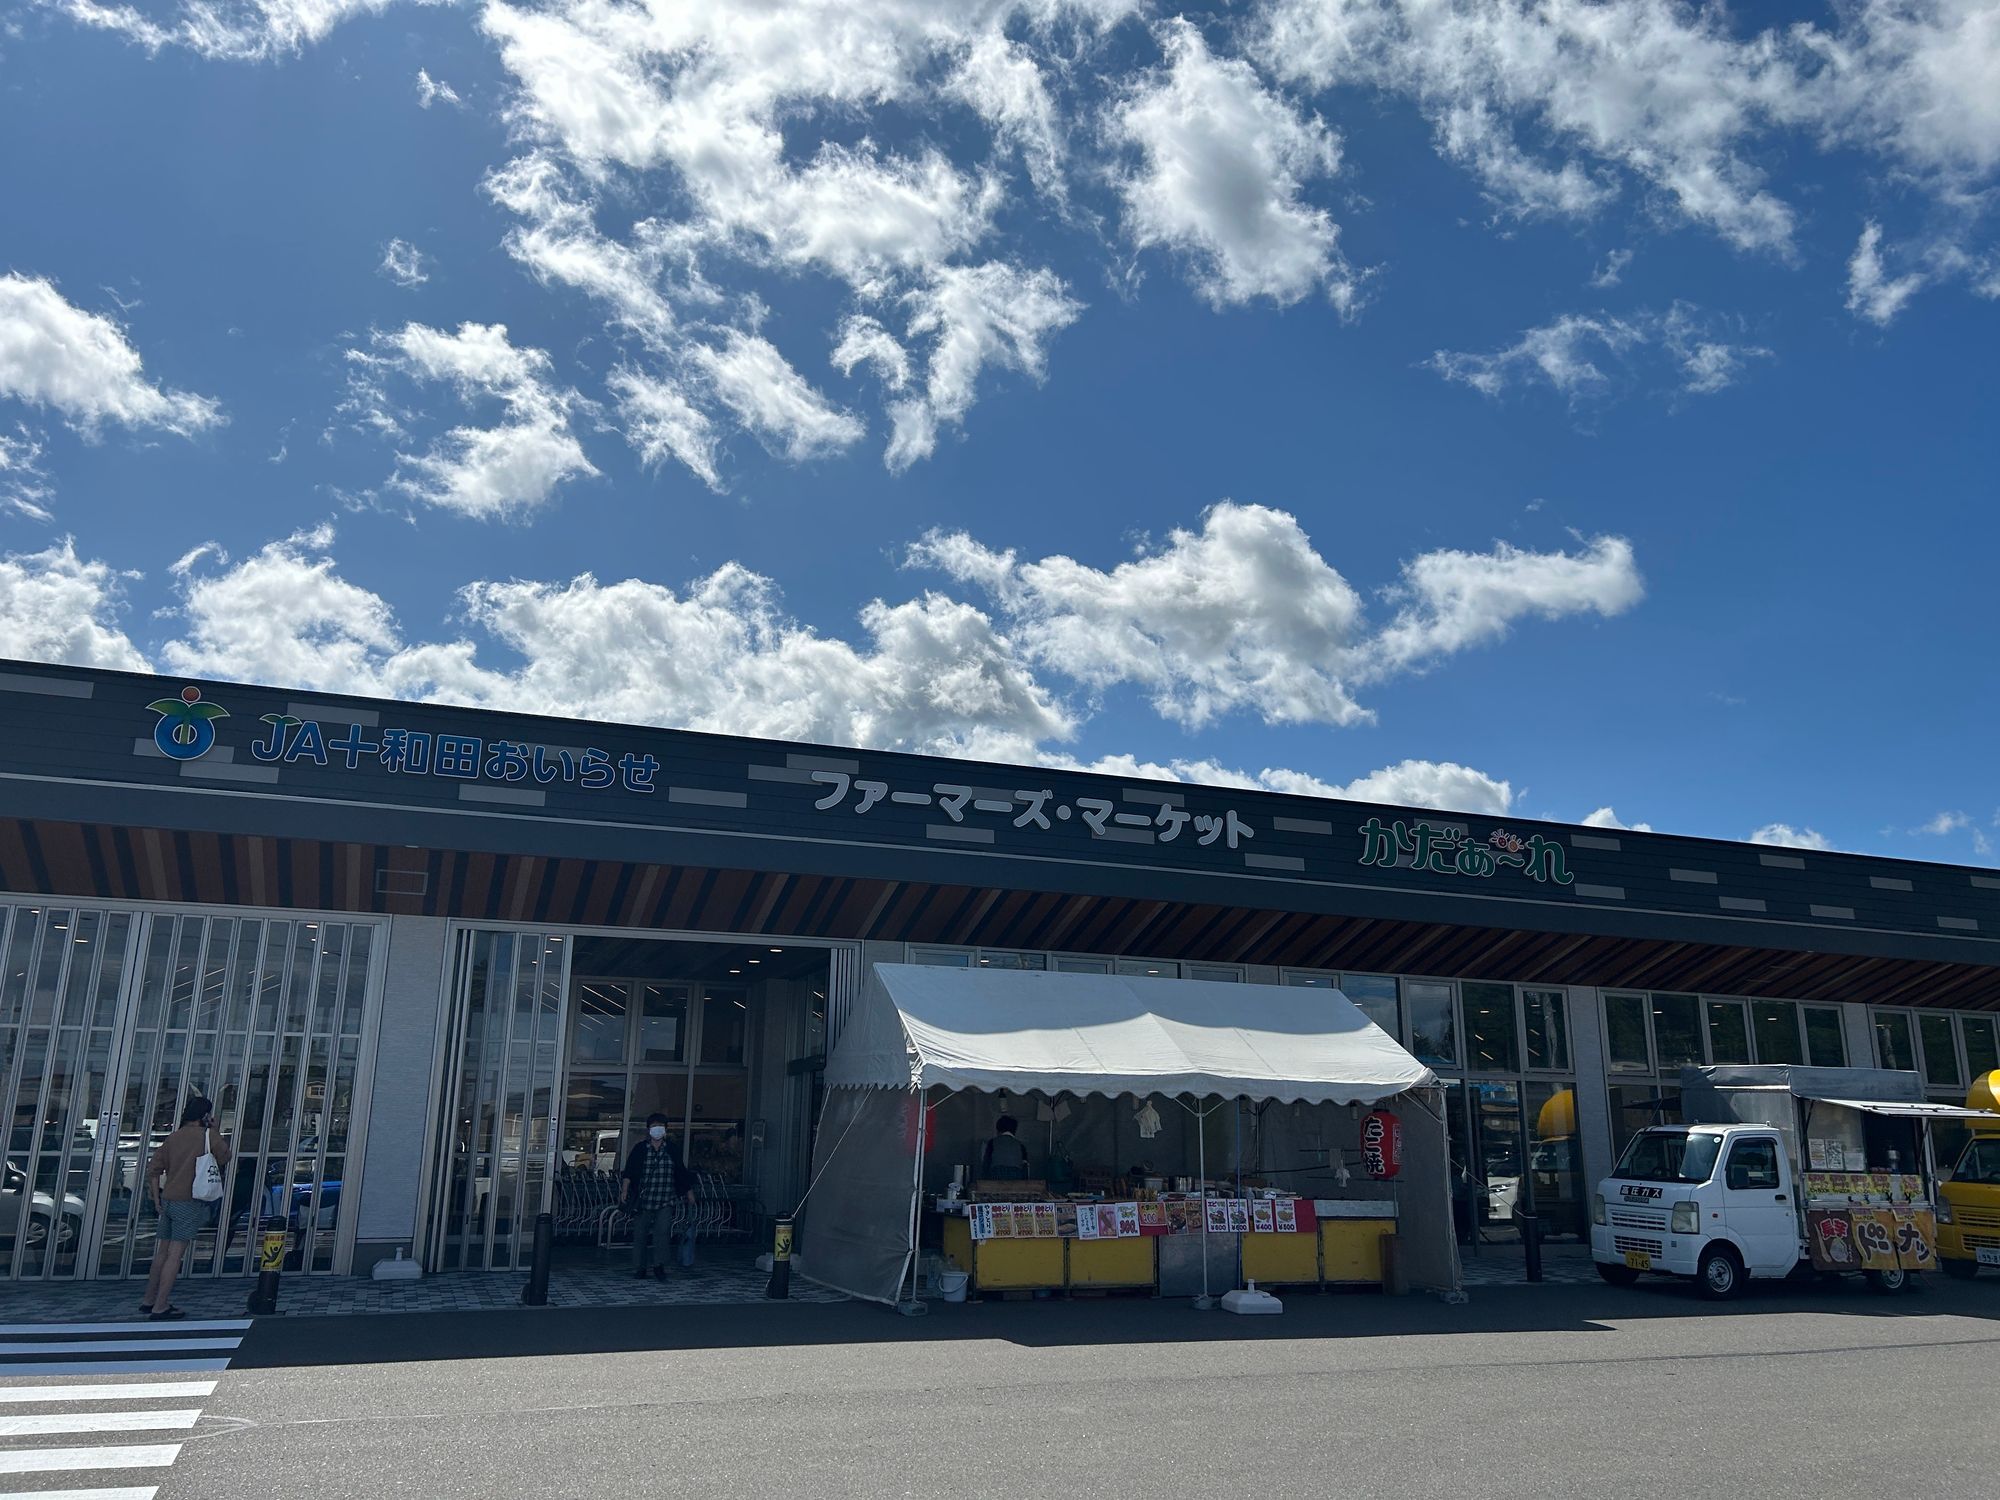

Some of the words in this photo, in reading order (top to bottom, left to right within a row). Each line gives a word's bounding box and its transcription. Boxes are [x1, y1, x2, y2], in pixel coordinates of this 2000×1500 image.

[251, 714, 660, 793] JA十和田おいらせ
[810, 770, 1255, 849] ファーマーズ・マーケット
[1621, 1186, 1661, 1198] 高圧ガス
